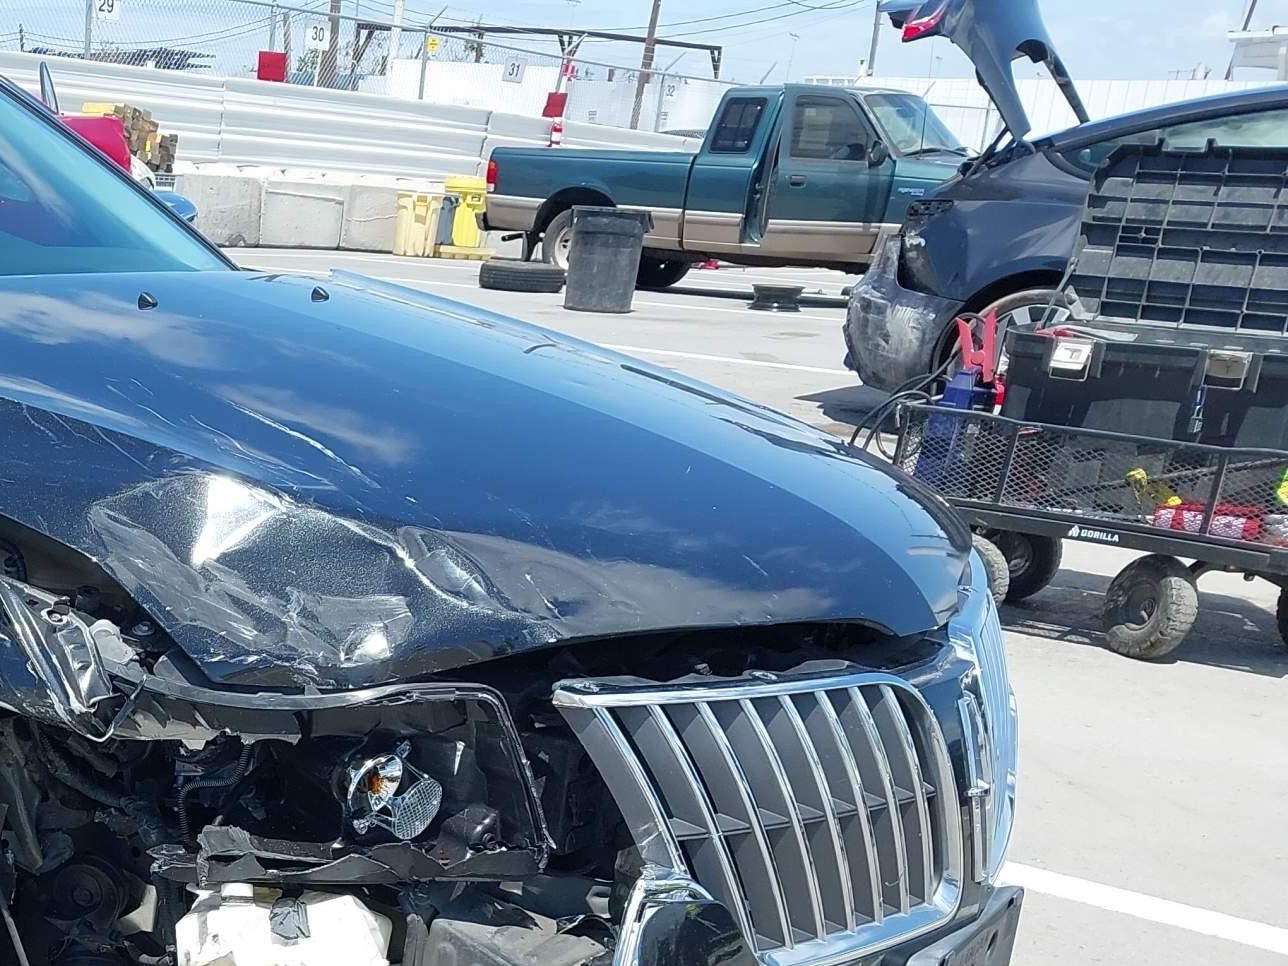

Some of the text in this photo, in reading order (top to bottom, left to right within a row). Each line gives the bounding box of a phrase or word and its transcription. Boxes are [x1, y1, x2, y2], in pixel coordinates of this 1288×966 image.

[98, 0, 114, 13] 29
[312, 25, 324, 42] 30
[508, 62, 520, 77] 31
[1081, 529, 1119, 542] GORILLA
